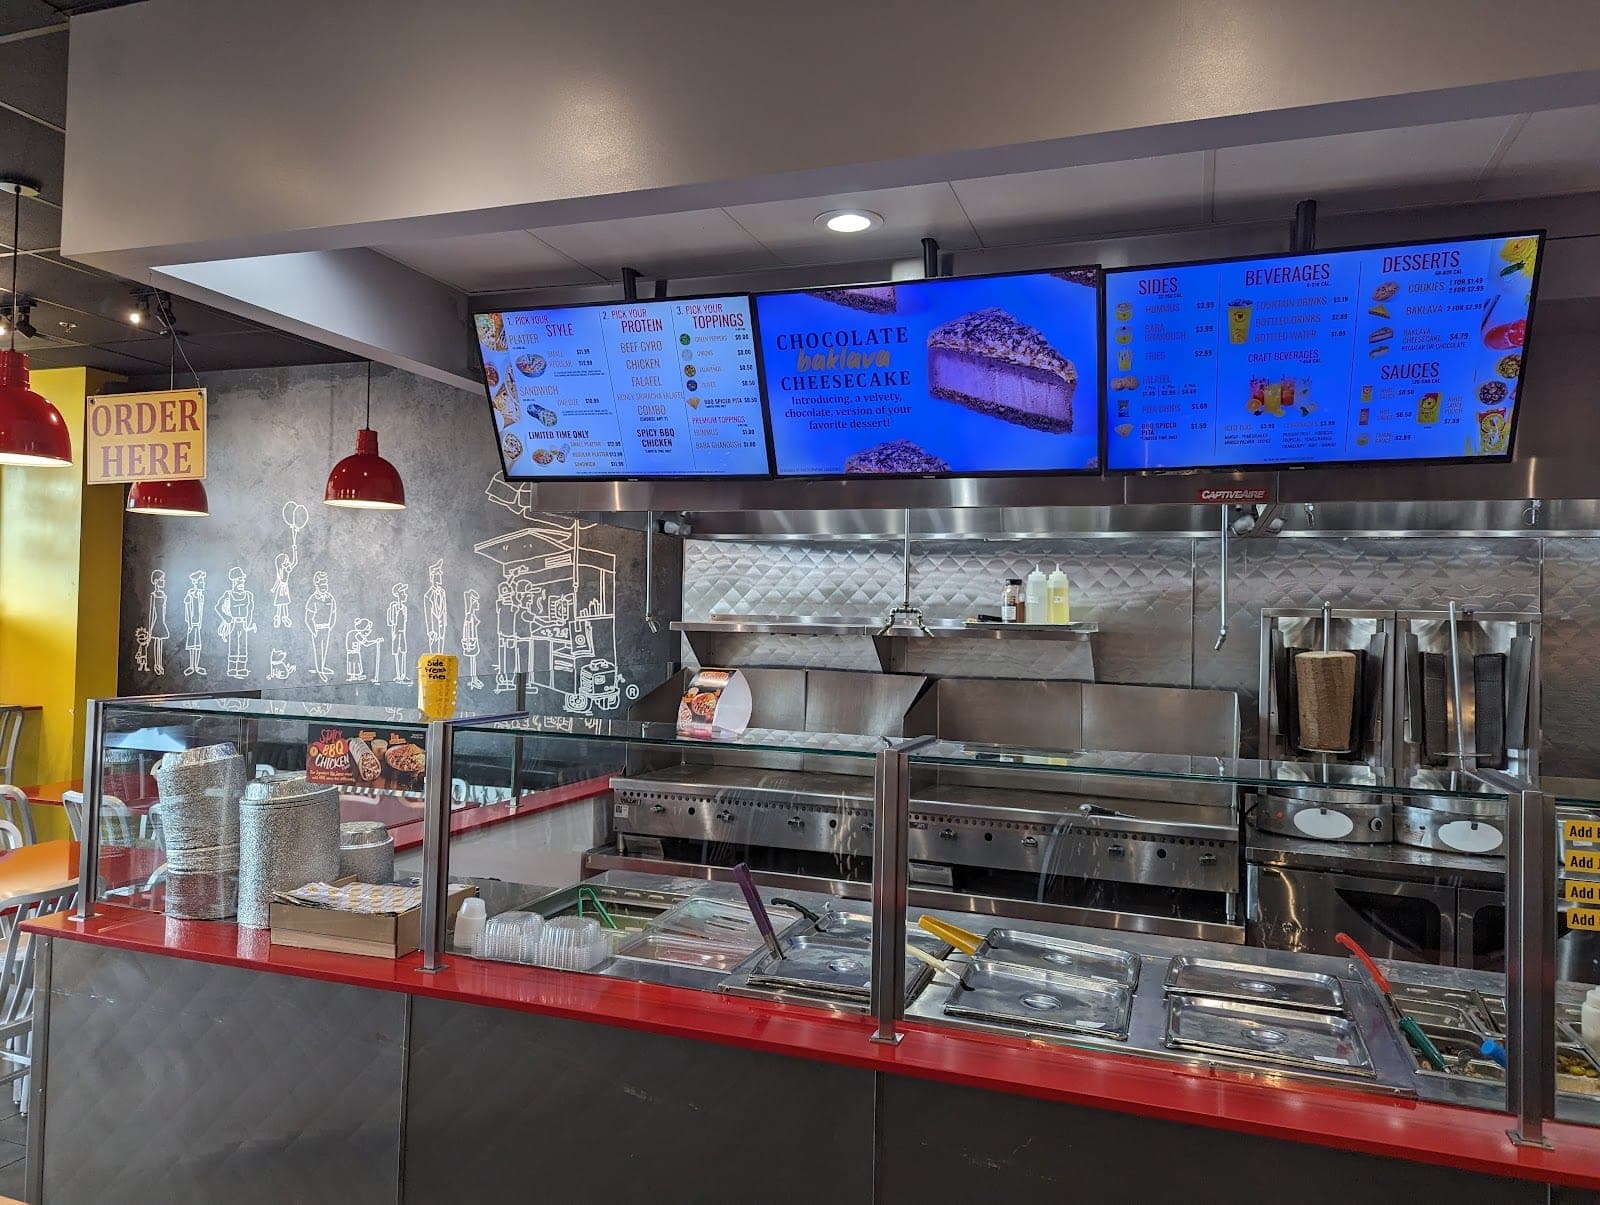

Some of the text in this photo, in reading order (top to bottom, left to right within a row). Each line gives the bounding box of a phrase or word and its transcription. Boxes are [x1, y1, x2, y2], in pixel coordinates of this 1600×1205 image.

[1382, 250, 1461, 273] DESSERTS
[1245, 263, 1330, 286] BEVERAGES
[1138, 277, 1178, 295] SIDES
[1408, 282, 1445, 293] COOKIES
[611, 310, 627, 319] PICK
[629, 309, 647, 318] YOUR
[677, 304, 723, 315] 3. PICK YOUR
[1406, 304, 1443, 316] BAKLAVA
[515, 316, 529, 325] PICK
[531, 315, 548, 324] YOUR
[621, 319, 663, 334] PROTEIN
[692, 313, 744, 329] TOPPINGS
[545, 324, 574, 337] STYLE
[508, 333, 539, 344] PLATTER
[776, 326, 909, 350] CHOCOLATE
[621, 340, 663, 353] BEEF GYRO
[797, 347, 891, 372] baklava
[1248, 349, 1319, 363] CRAFT BEVERAGES
[626, 359, 660, 370] CHICKEN
[1381, 362, 1440, 380] SAUCES
[632, 376, 661, 387] FALAFEL
[781, 370, 911, 391] CHEESECAKE
[520, 385, 559, 397] SANDWICH
[863, 392, 902, 403] velvety,
[637, 404, 666, 415] COMBO
[785, 405, 912, 418] chocolate, version of your
[92, 400, 200, 437] ORDER
[809, 418, 890, 430] favorite dessert!
[528, 430, 589, 440] LIMITED TIME ONLY
[636, 428, 675, 437] SPICY BBQ
[641, 439, 673, 447] CHICKEN
[101, 442, 192, 477] HERE
[1202, 490, 1265, 499] CAPTIVEAIRE
[427, 659, 444, 667] Side
[320, 728, 343, 743] SPICY
[322, 740, 344, 758] BBQ
[315, 754, 350, 770] CHICKEN
[1569, 825, 1592, 838] Add
[1570, 856, 1593, 869] Add
[1571, 886, 1593, 899] Add
[1572, 913, 1594, 926] Add
